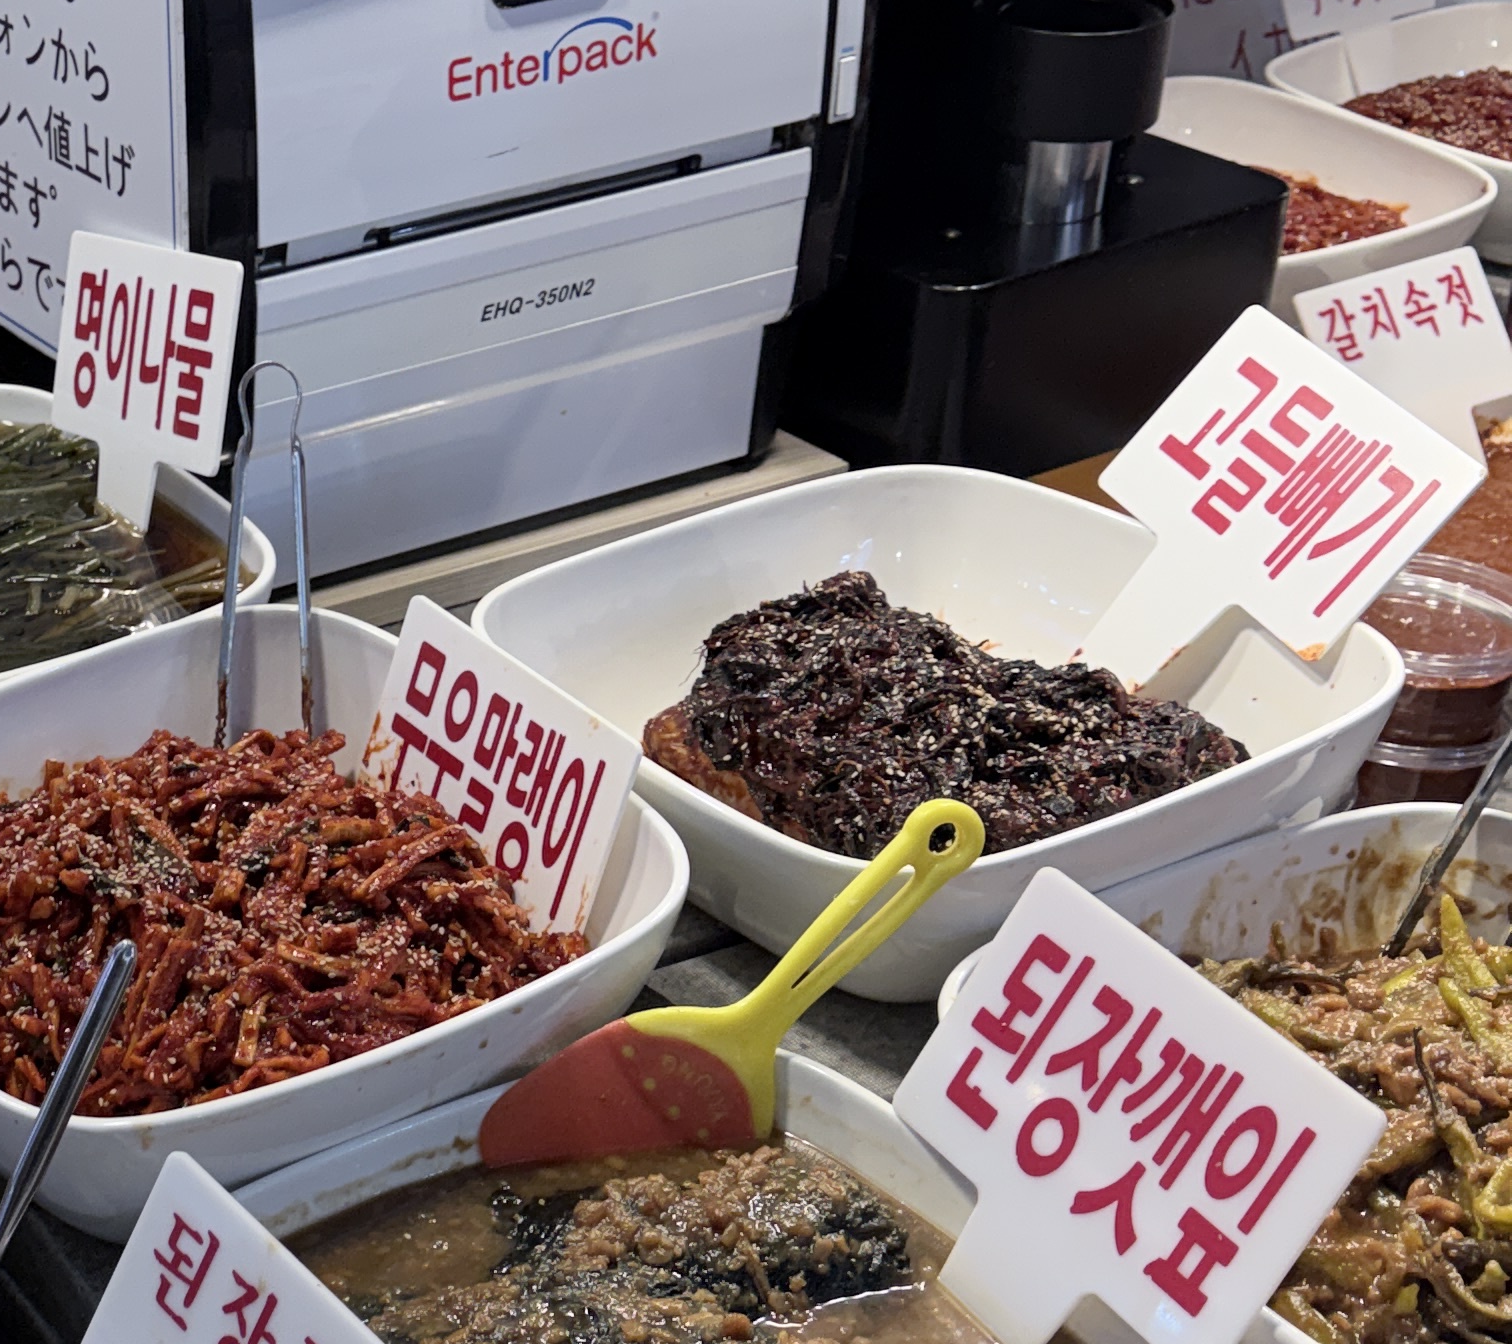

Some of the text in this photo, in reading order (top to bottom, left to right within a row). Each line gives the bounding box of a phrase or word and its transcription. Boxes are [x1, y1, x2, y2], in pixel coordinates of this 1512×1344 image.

[447, 17, 659, 102] Enterpack
[72, 267, 216, 442] 명이나물
[480, 277, 596, 324] EHQ-350N2
[1318, 264, 1485, 364] 갈치속젓
[1158, 356, 1443, 619] 고들빼기
[389, 641, 606, 921] 무우말랭이
[945, 933, 1317, 1318] 된장깻잎
